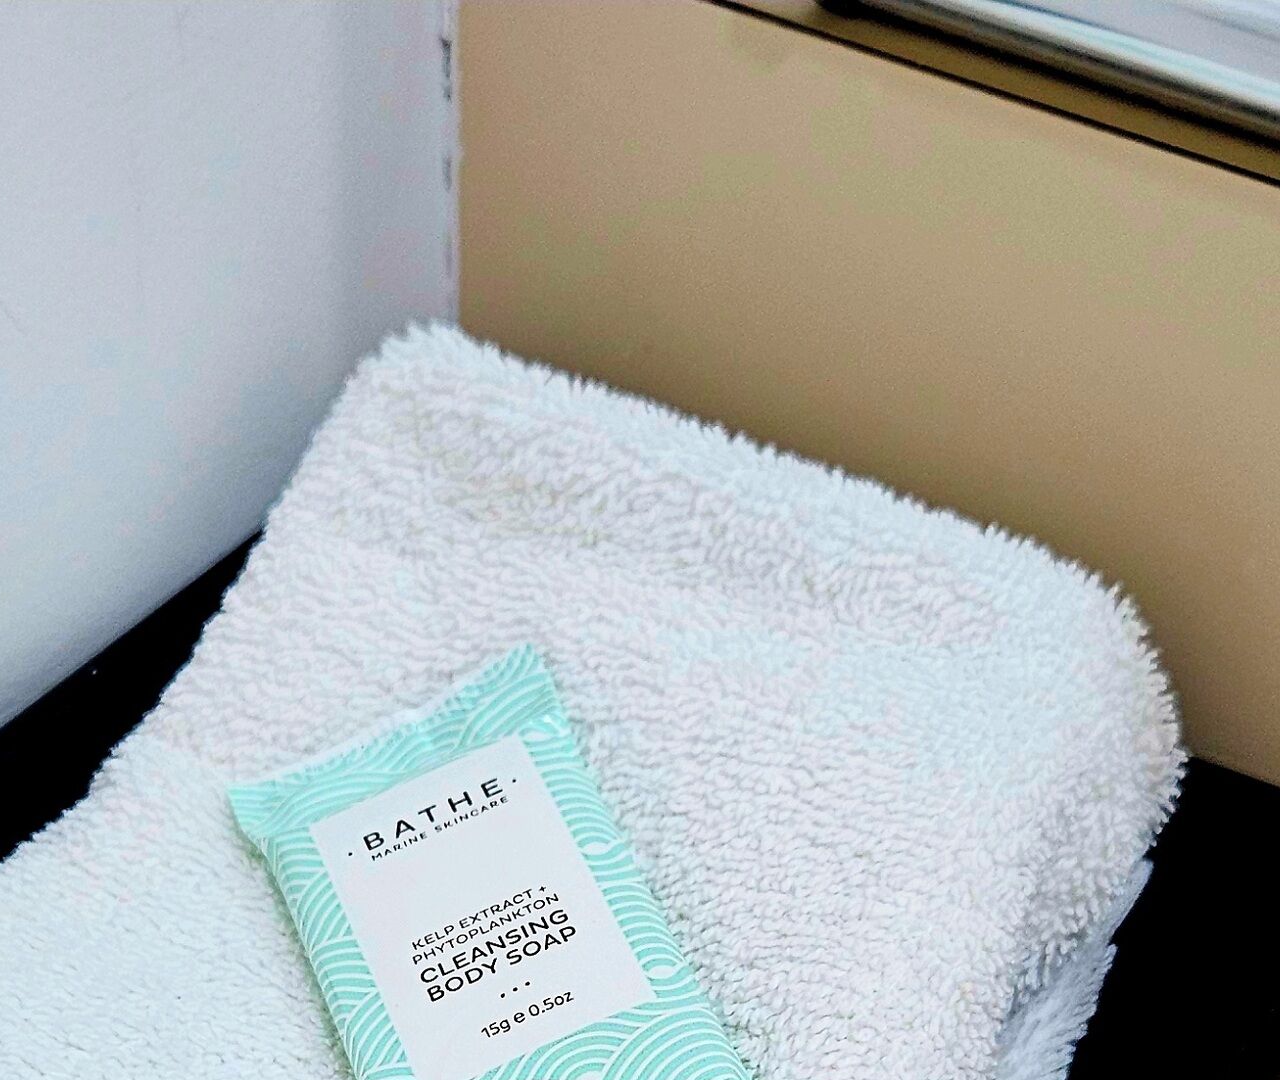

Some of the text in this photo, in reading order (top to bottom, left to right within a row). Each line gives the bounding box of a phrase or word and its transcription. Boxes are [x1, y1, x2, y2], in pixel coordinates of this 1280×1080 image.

[362, 777, 504, 851] BATHE
[371, 795, 510, 862] MARINE SKINCARE
[411, 917, 455, 951] KELP
[458, 888, 533, 929] EXTRACT
[412, 893, 559, 966] PHYTOPLANKTON
[420, 909, 569, 984] CLEANSING
[426, 925, 577, 1003] BODY SOAP
[480, 1018, 511, 1038] 15g
[528, 991, 575, 1017] 0.5oz
